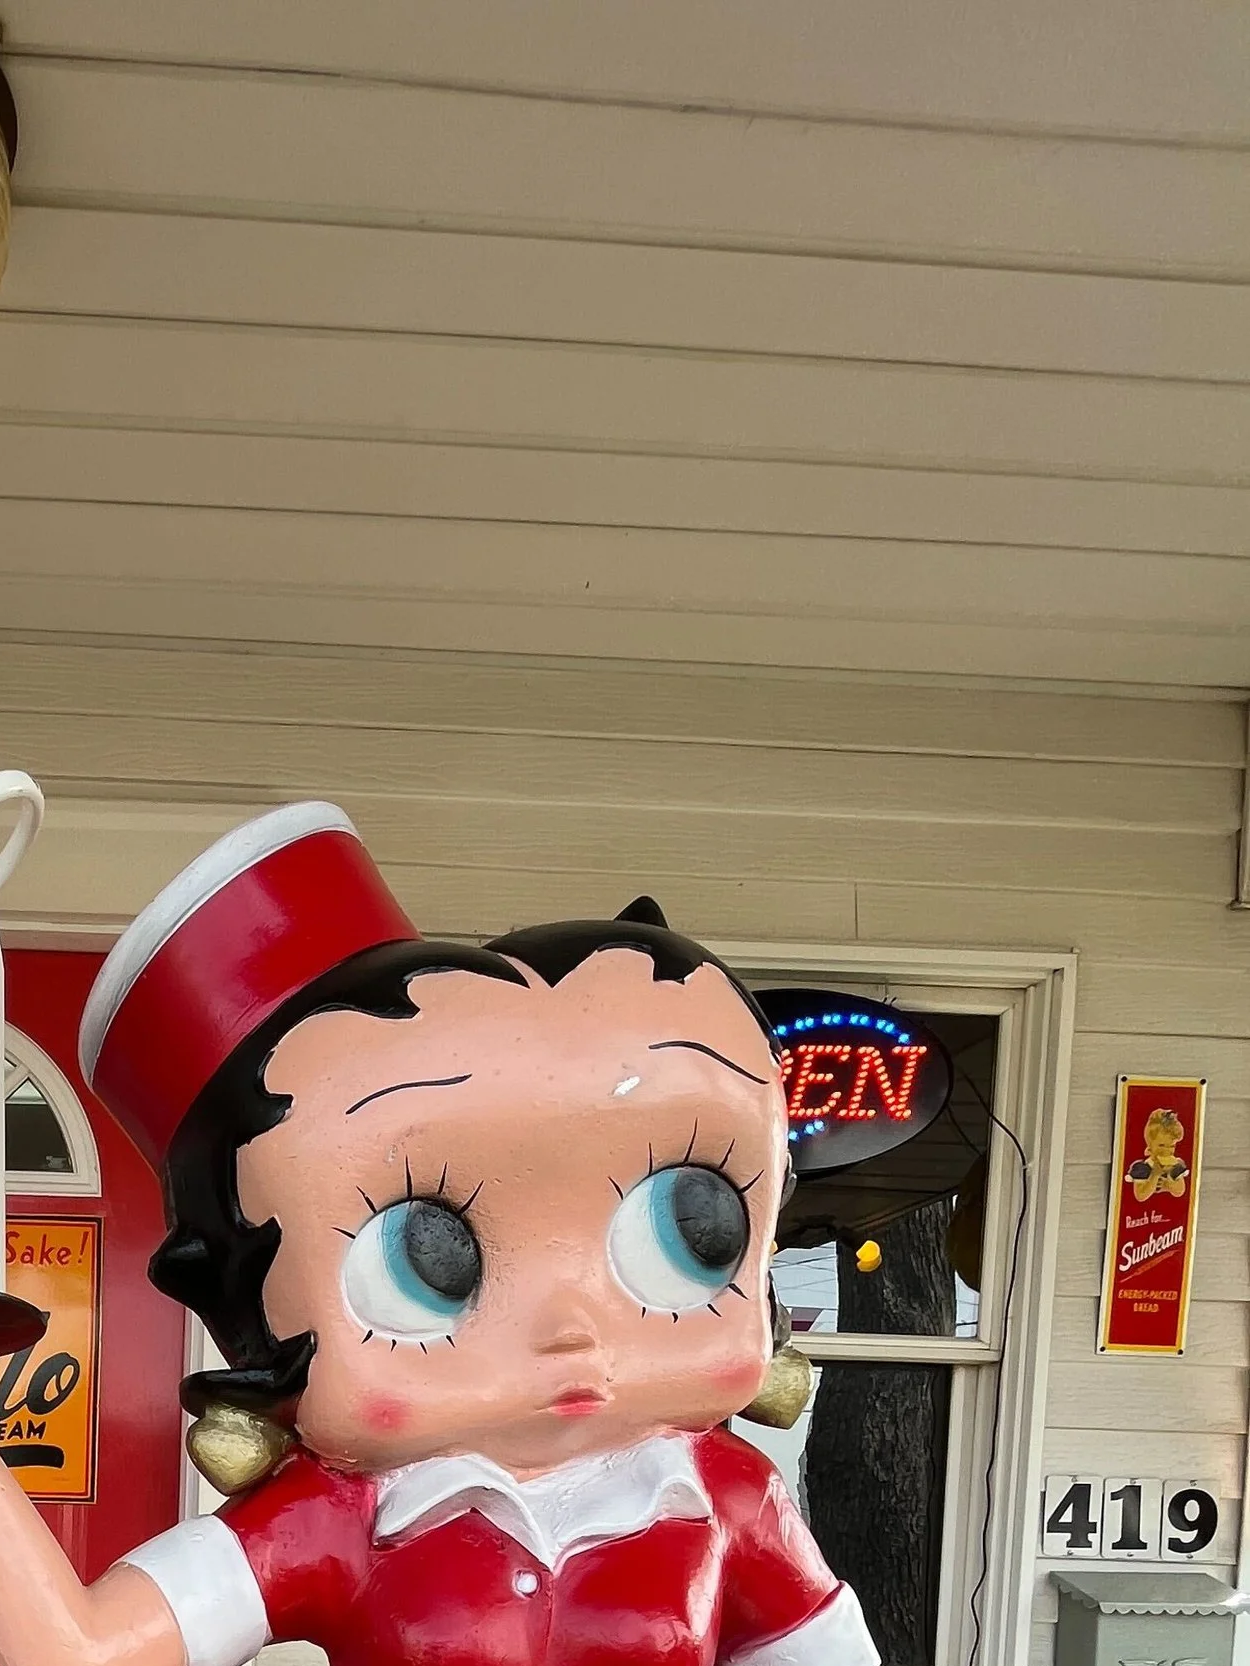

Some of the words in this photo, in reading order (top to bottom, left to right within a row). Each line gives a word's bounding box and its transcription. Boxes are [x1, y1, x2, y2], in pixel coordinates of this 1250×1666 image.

[781, 1044, 928, 1120] EN
[1125, 1211, 1149, 1229] Reach
[5, 1230, 90, 1266] Sake!
[1118, 1225, 1184, 1272] Sunbeam
[1118, 1289, 1178, 1301] ENERGY-PACKED
[1133, 1303, 1160, 1313] BREAD
[1047, 1483, 1218, 1554] 419
